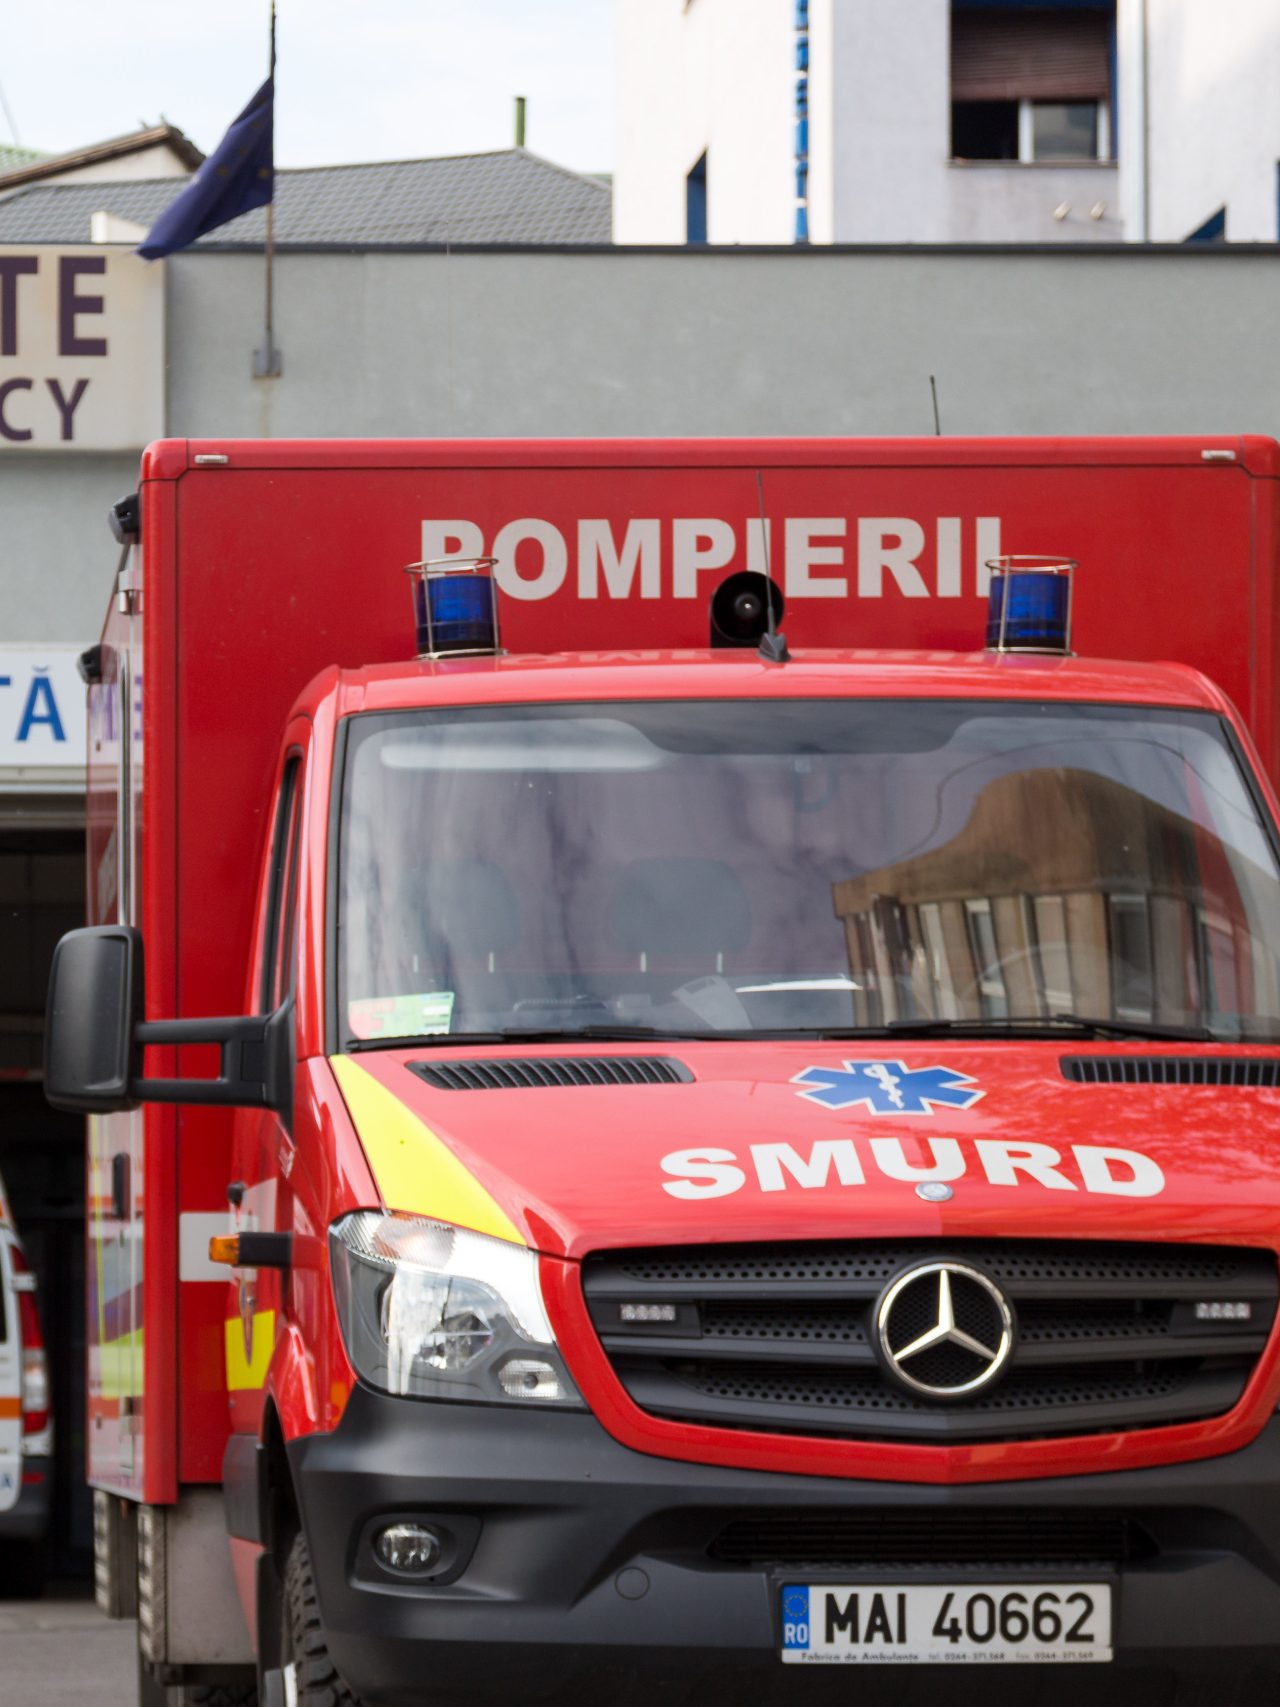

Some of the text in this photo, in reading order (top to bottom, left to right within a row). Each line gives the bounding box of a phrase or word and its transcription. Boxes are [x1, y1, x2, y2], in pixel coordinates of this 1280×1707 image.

[420, 517, 1003, 601] POMPIERII
[660, 1137, 1166, 1200] SMURD
[783, 1623, 809, 1645] RO
[824, 1591, 1096, 1645] MAI 40662
[801, 1652, 840, 1662] Fabrica
[844, 1652, 857, 1662] de
